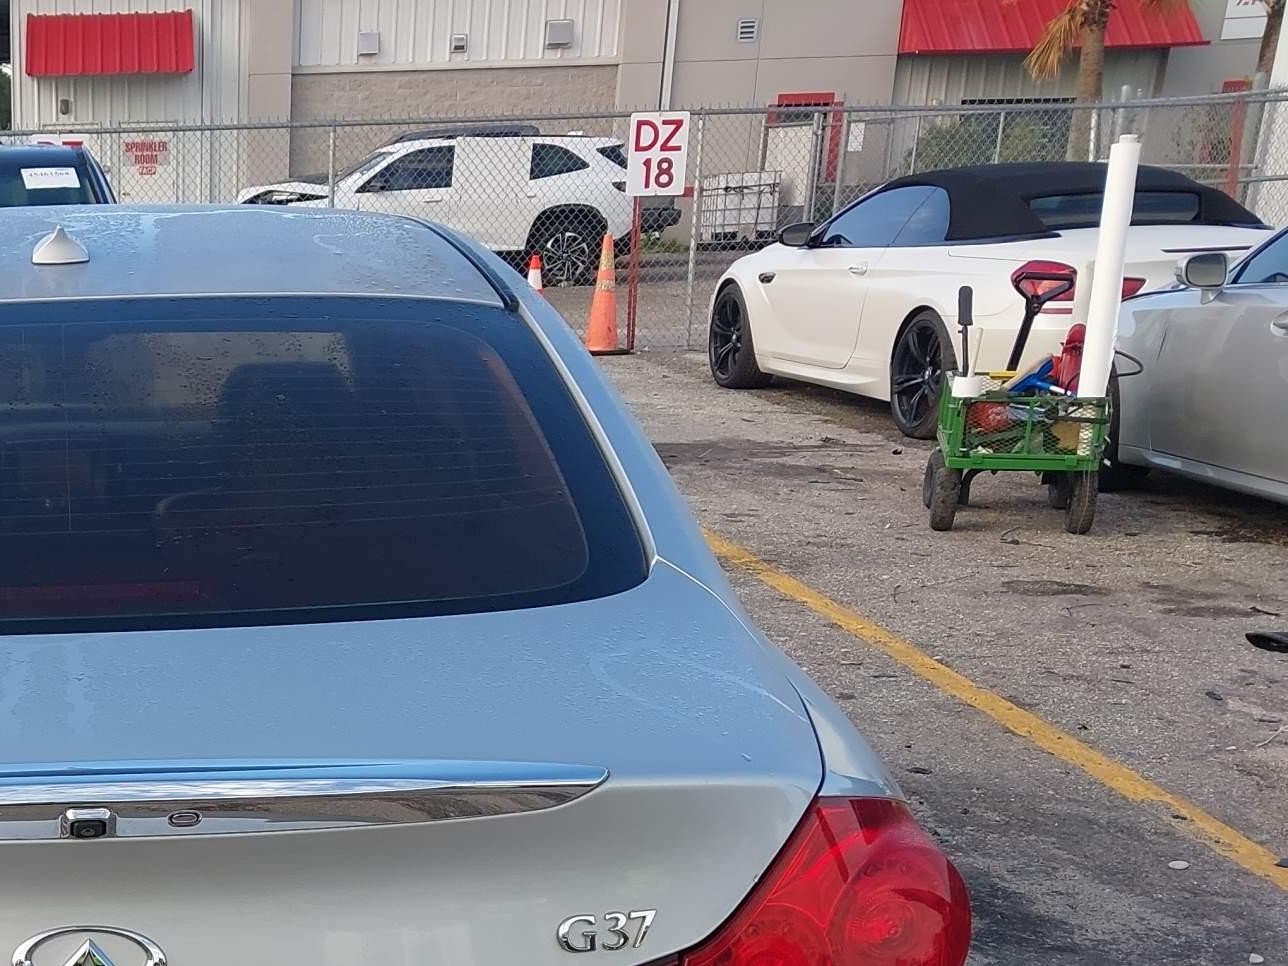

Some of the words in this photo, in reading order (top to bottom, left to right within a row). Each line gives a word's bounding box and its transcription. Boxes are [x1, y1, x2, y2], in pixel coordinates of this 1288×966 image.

[125, 142, 168, 153] SPRINKLER
[635, 119, 684, 152] DZ
[135, 154, 158, 164] ROOM
[642, 157, 674, 189] 18
[556, 908, 657, 953] G37
